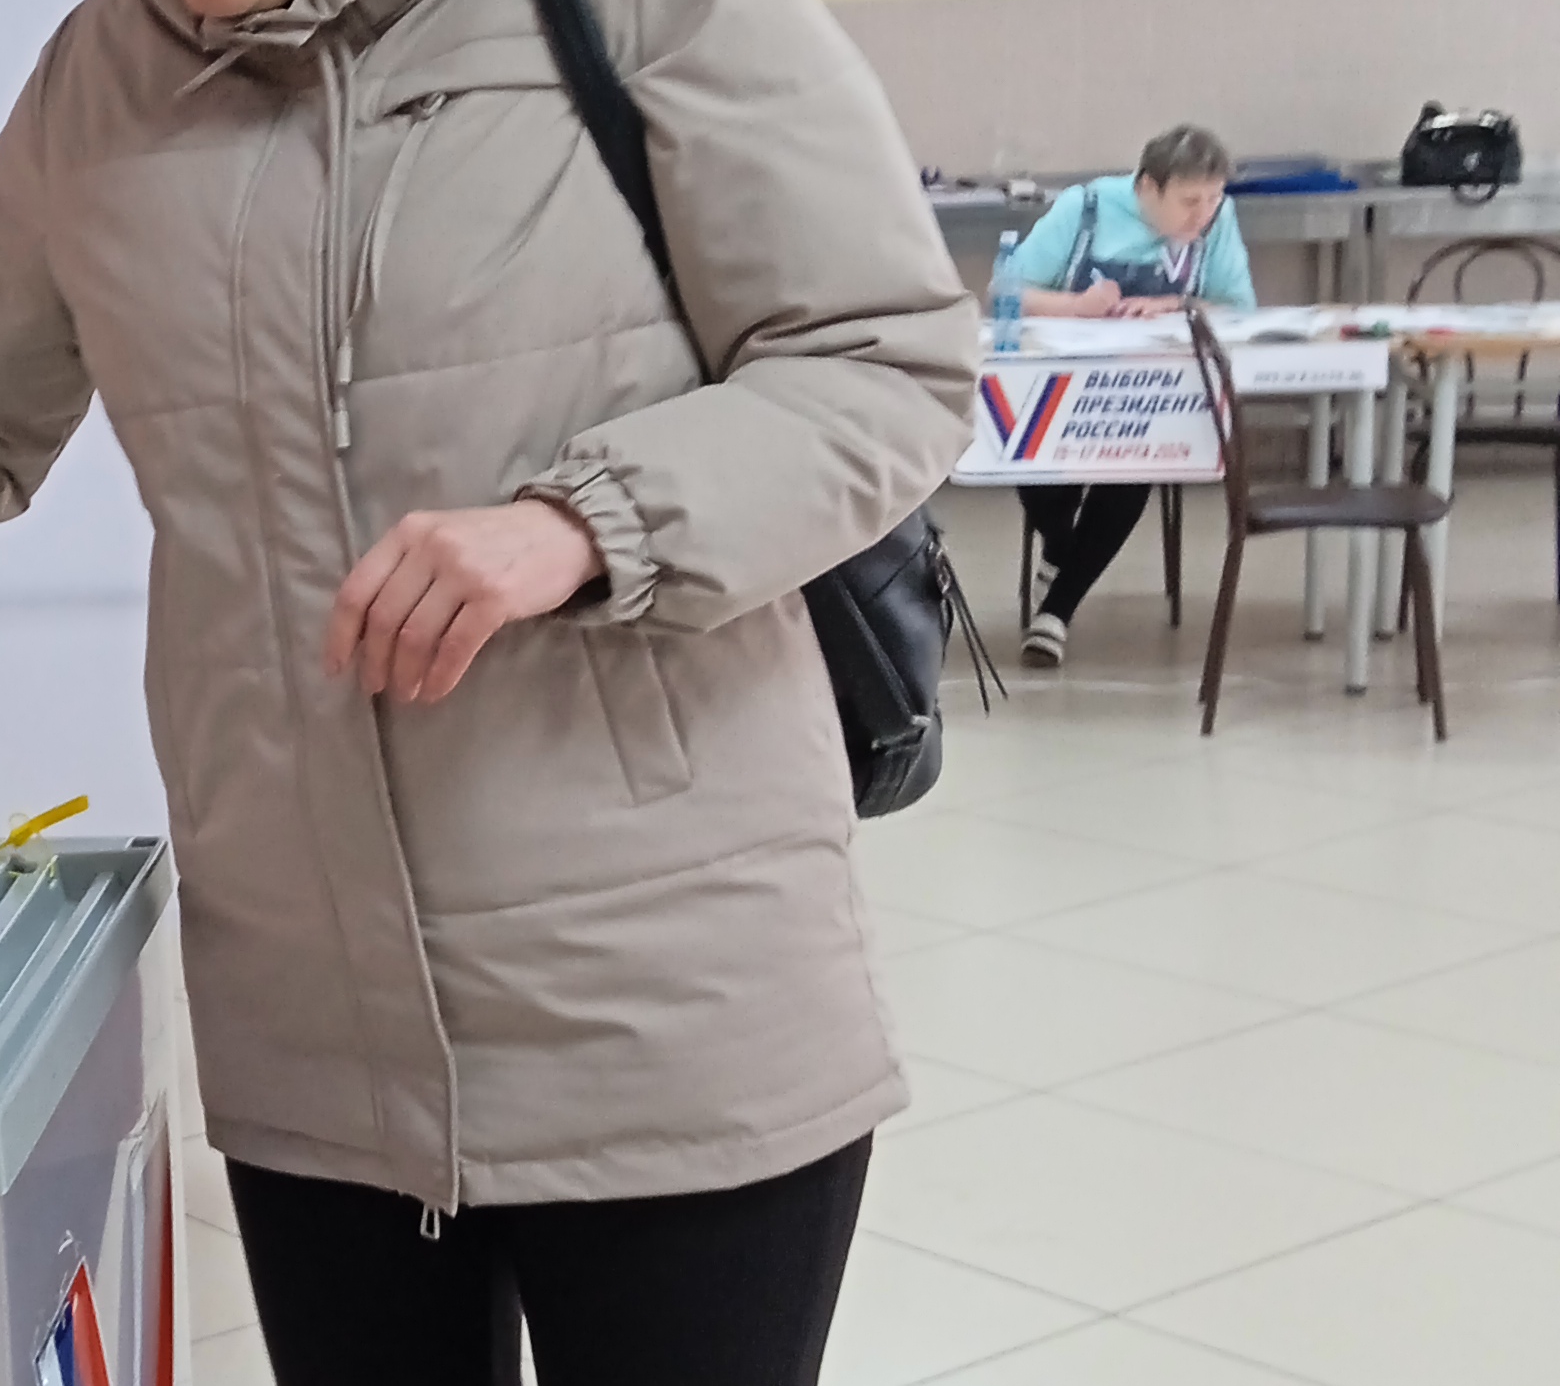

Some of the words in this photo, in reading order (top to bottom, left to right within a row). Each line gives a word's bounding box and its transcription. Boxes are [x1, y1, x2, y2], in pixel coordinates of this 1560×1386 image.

[1084, 369, 1184, 390] ВЫБОРЫ
[1073, 393, 1212, 413] ПРЕЗИДЕНТА
[1062, 420, 1151, 439] РОССИИ
